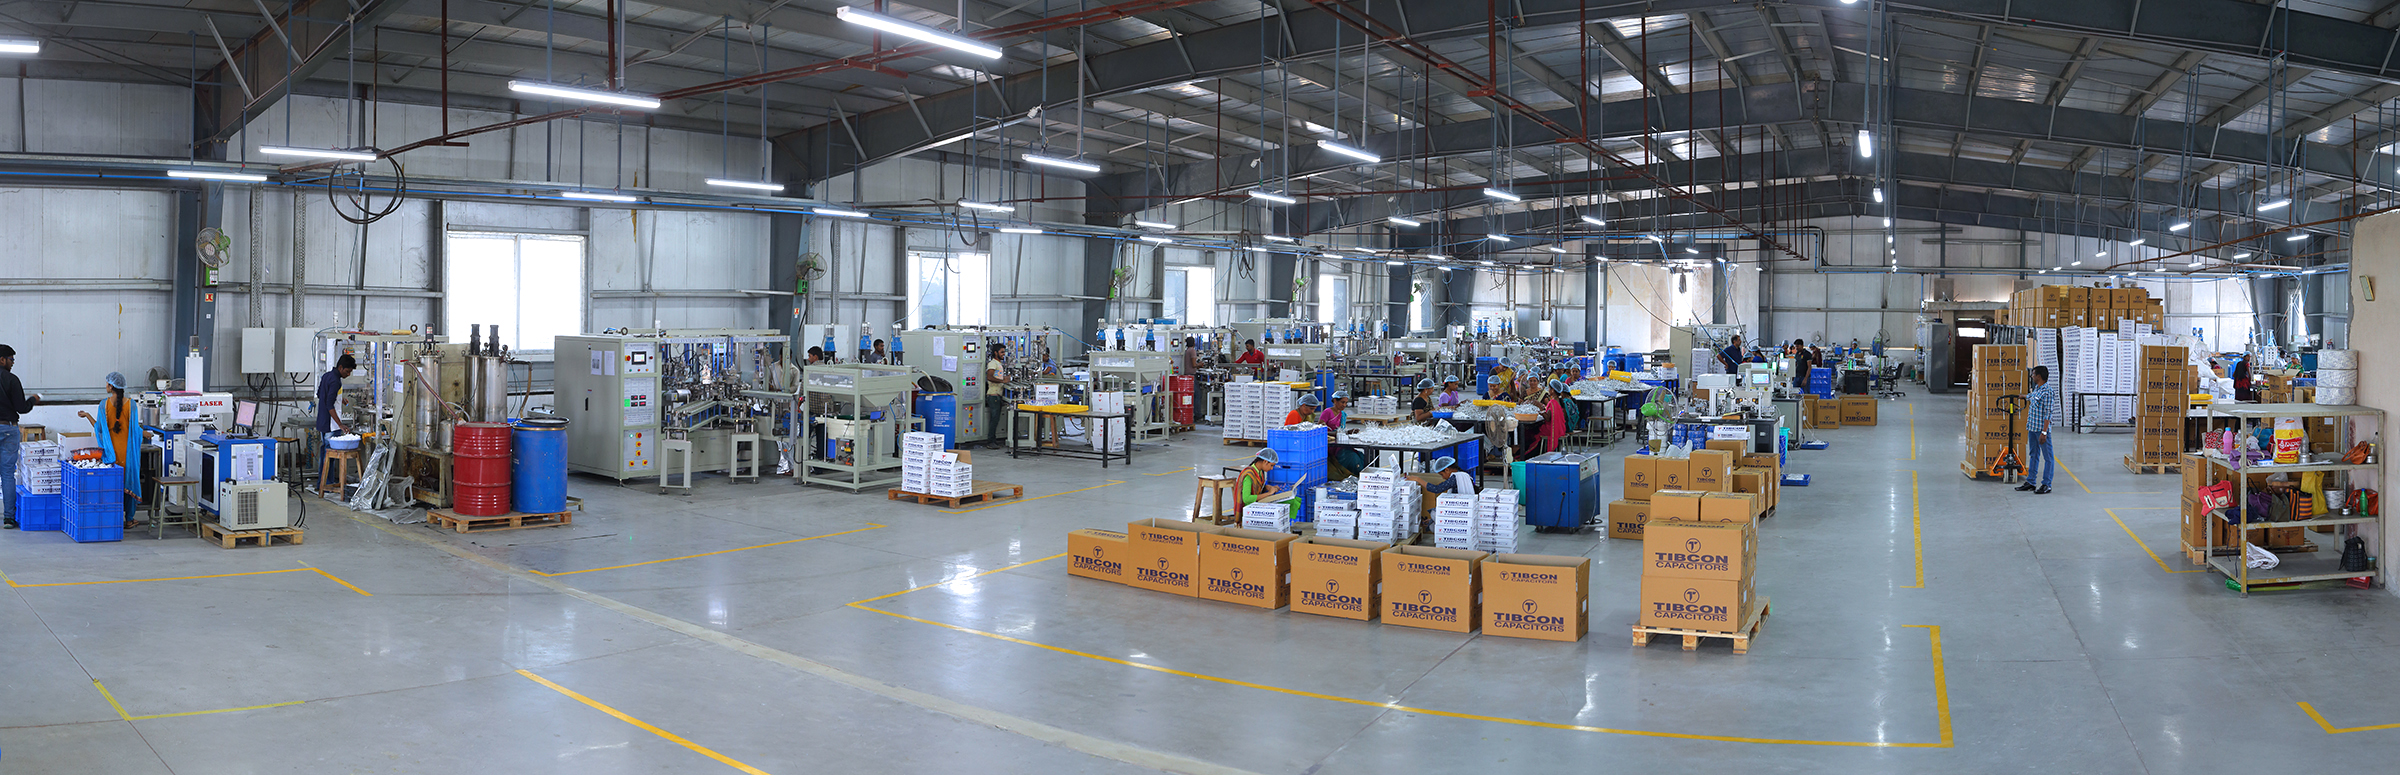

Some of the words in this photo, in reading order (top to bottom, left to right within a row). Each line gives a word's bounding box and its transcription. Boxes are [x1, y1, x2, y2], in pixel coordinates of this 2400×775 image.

[1148, 533, 1183, 541] TIBCON
[1221, 542, 1260, 552] TIBCON
[1073, 555, 1122, 569] TIBCON
[1317, 552, 1358, 562] TIBCON
[1655, 552, 1728, 563] TIBCON
[1074, 561, 1122, 576] CAPACITORS
[1408, 562, 1450, 571] TIBCON
[1656, 561, 1728, 571] CAPACITORS
[1137, 567, 1189, 580] TIBCON
[1510, 572, 1557, 580] TIBCON
[1137, 574, 1189, 588] CAPACITORS
[1208, 577, 1264, 592] TIBCON
[1208, 585, 1264, 600] CAPACITORS
[1301, 590, 1362, 605] TIBCON
[1301, 599, 1362, 612] CAPACITORS
[1392, 602, 1456, 615] TIBCON
[1654, 602, 1727, 614] TIBCON
[1392, 611, 1457, 622] CAPACITORS
[1494, 612, 1564, 625] TIBCON
[1654, 611, 1728, 622] CAPACITORS
[1494, 621, 1564, 632] CAPACITORS
